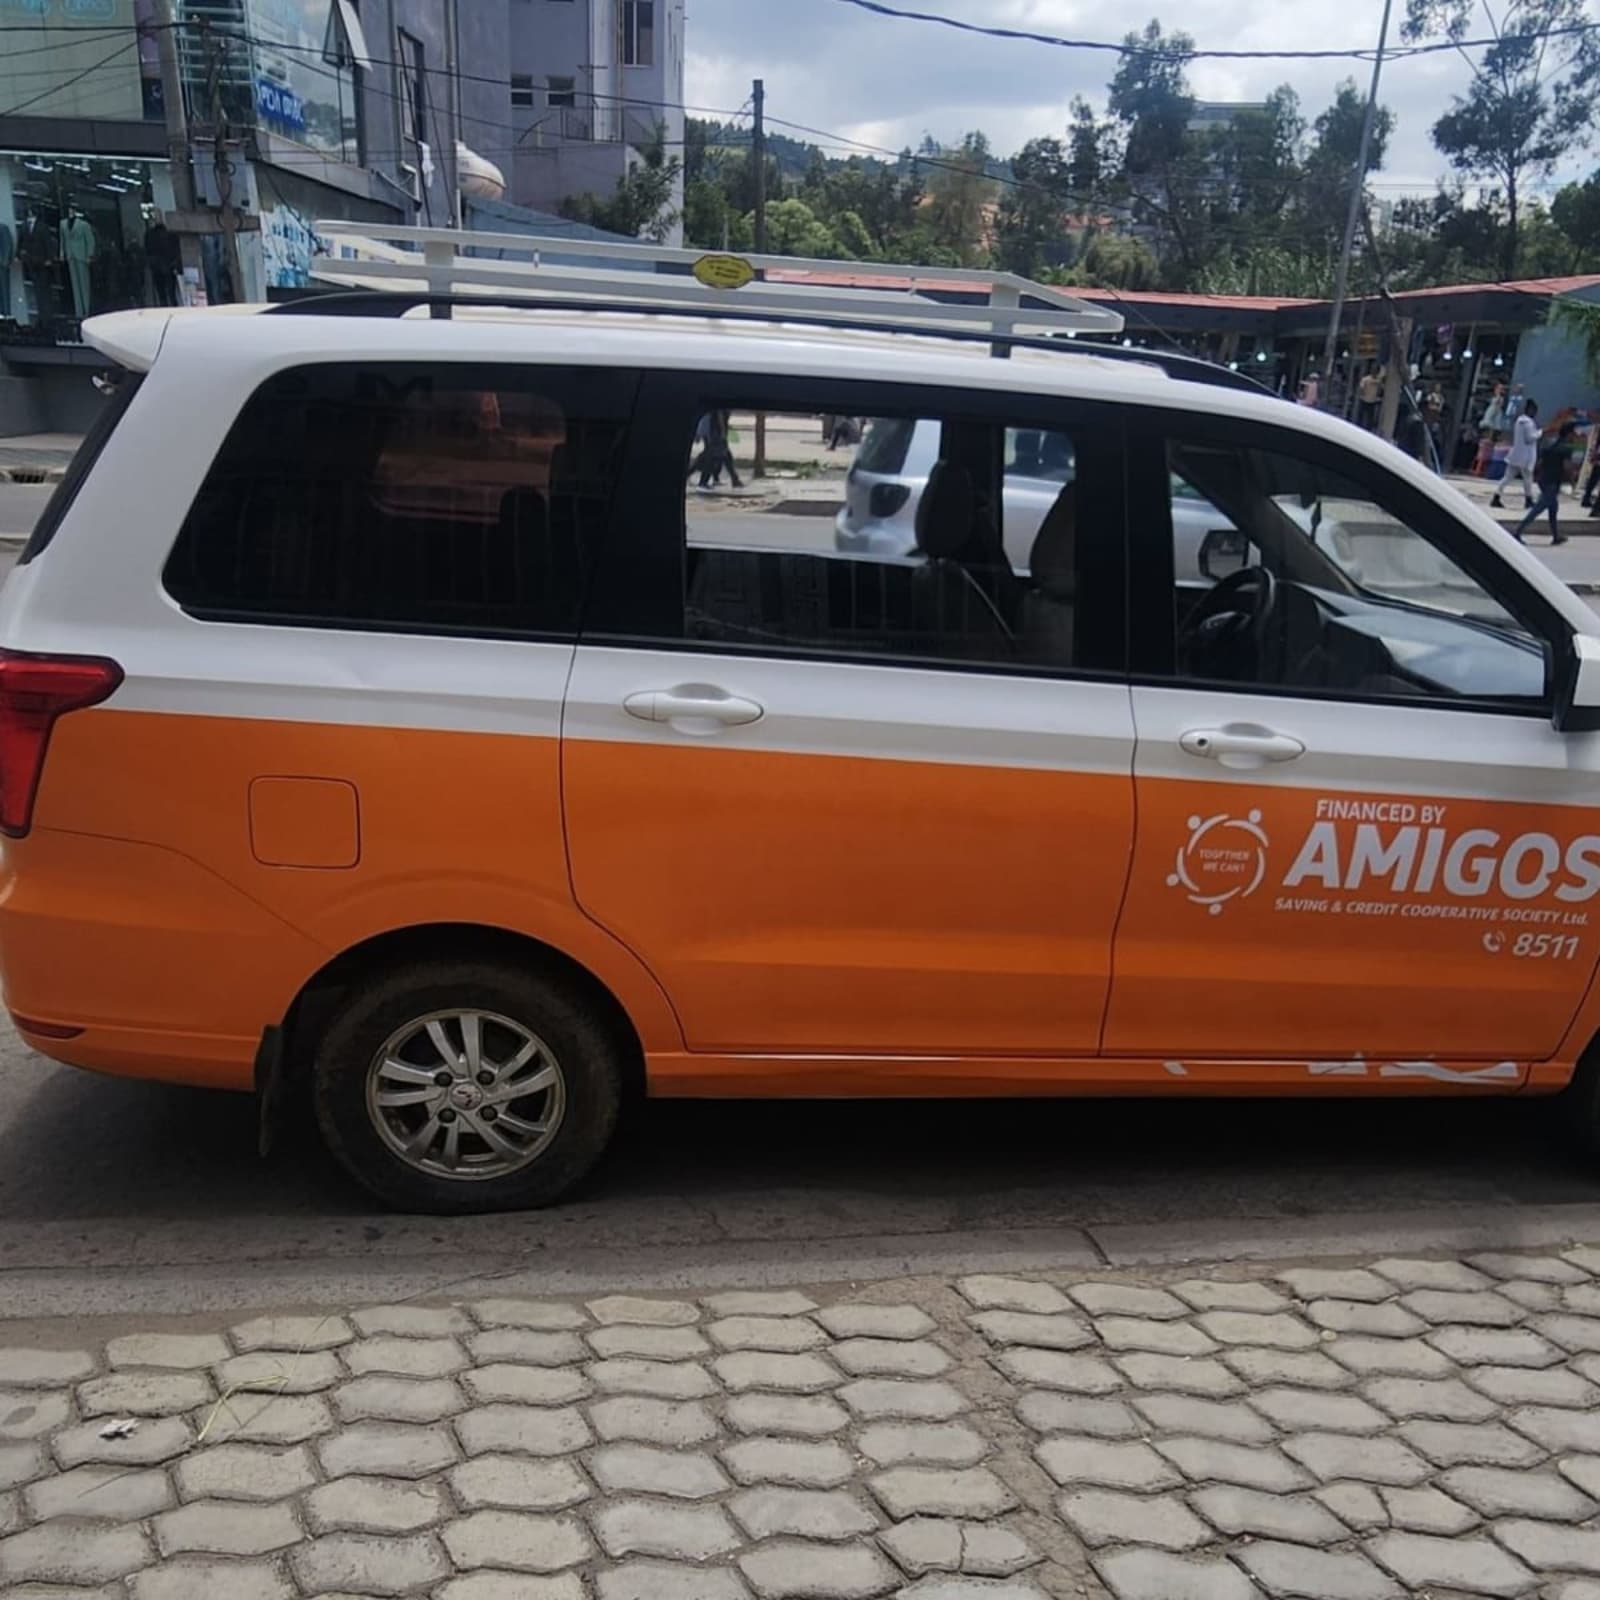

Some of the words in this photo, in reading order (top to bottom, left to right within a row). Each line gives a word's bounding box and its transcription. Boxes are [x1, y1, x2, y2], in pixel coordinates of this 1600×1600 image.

[1316, 799, 1415, 823] FINANCED
[1419, 805, 1447, 825] BY
[1282, 820, 1600, 902] AMIGOS
[1274, 898, 1329, 913] SAVING
[1331, 901, 1343, 913] &
[1346, 901, 1398, 916] CREDIT
[1400, 903, 1500, 921] COOPERATIVE
[1501, 908, 1562, 924] SOCIETY
[1562, 912, 1589, 926] Ltd.
[1512, 932, 1579, 960] 8511
